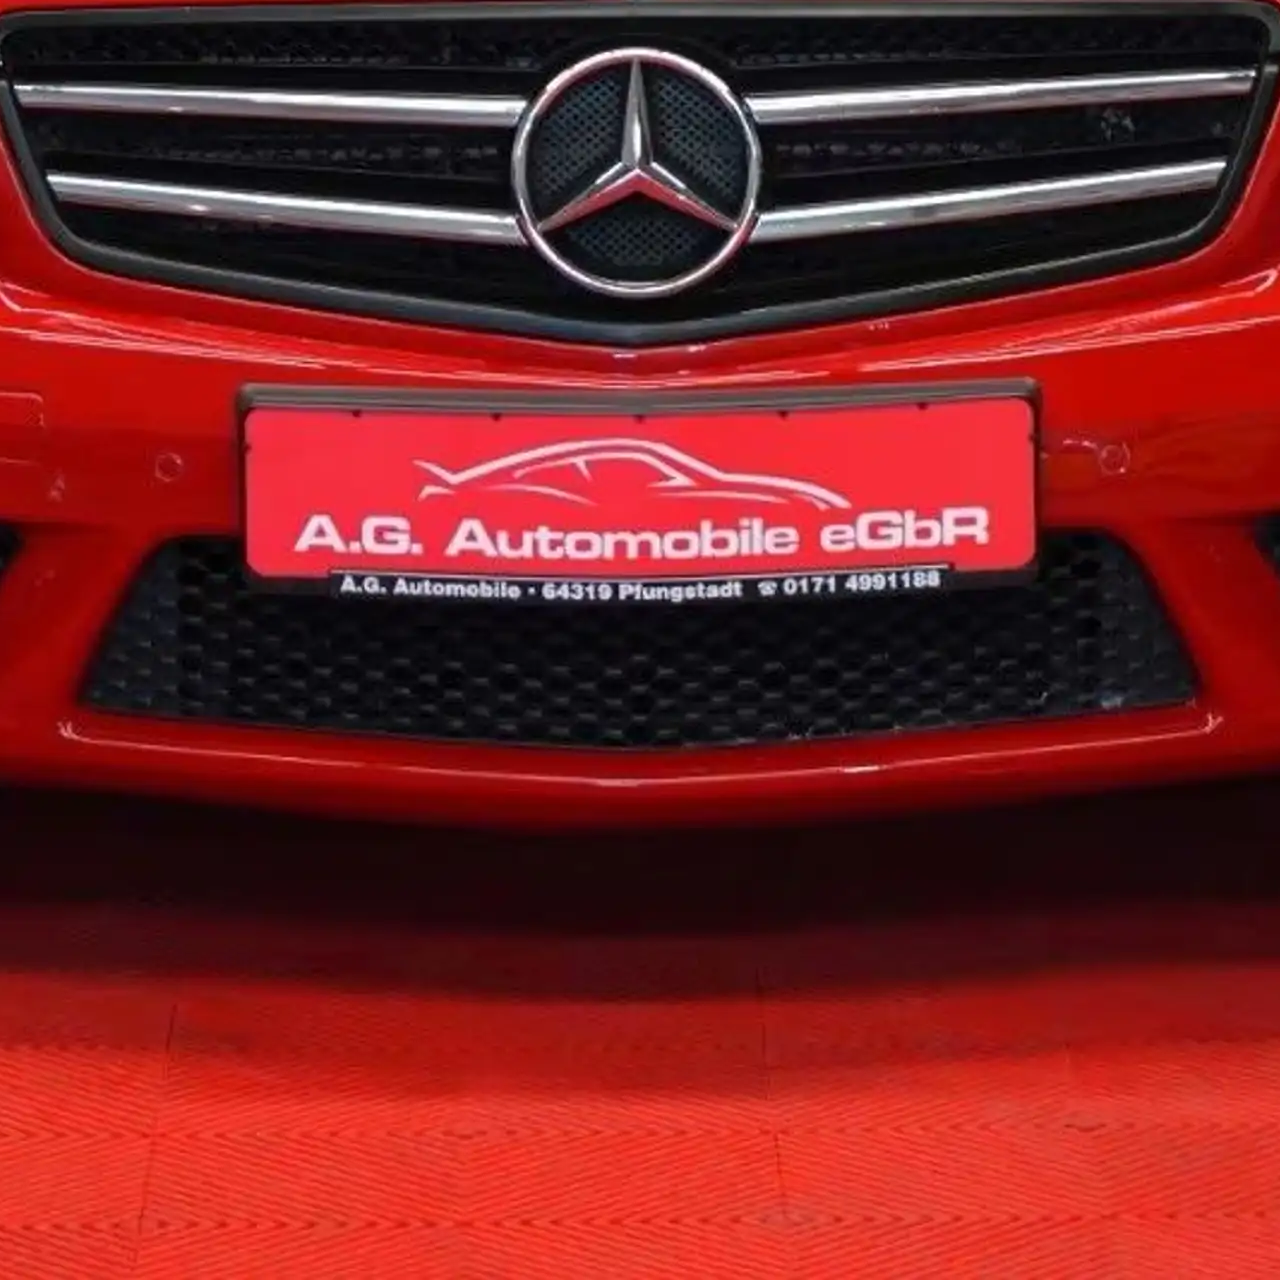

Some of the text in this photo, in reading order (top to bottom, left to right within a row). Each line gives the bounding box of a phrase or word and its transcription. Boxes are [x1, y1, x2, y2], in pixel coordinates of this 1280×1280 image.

[294, 506, 991, 560] A.G. Automobile eGbR
[339, 570, 941, 603] A.G. Automobile 64319 Pfungstadt 0171 4991188
